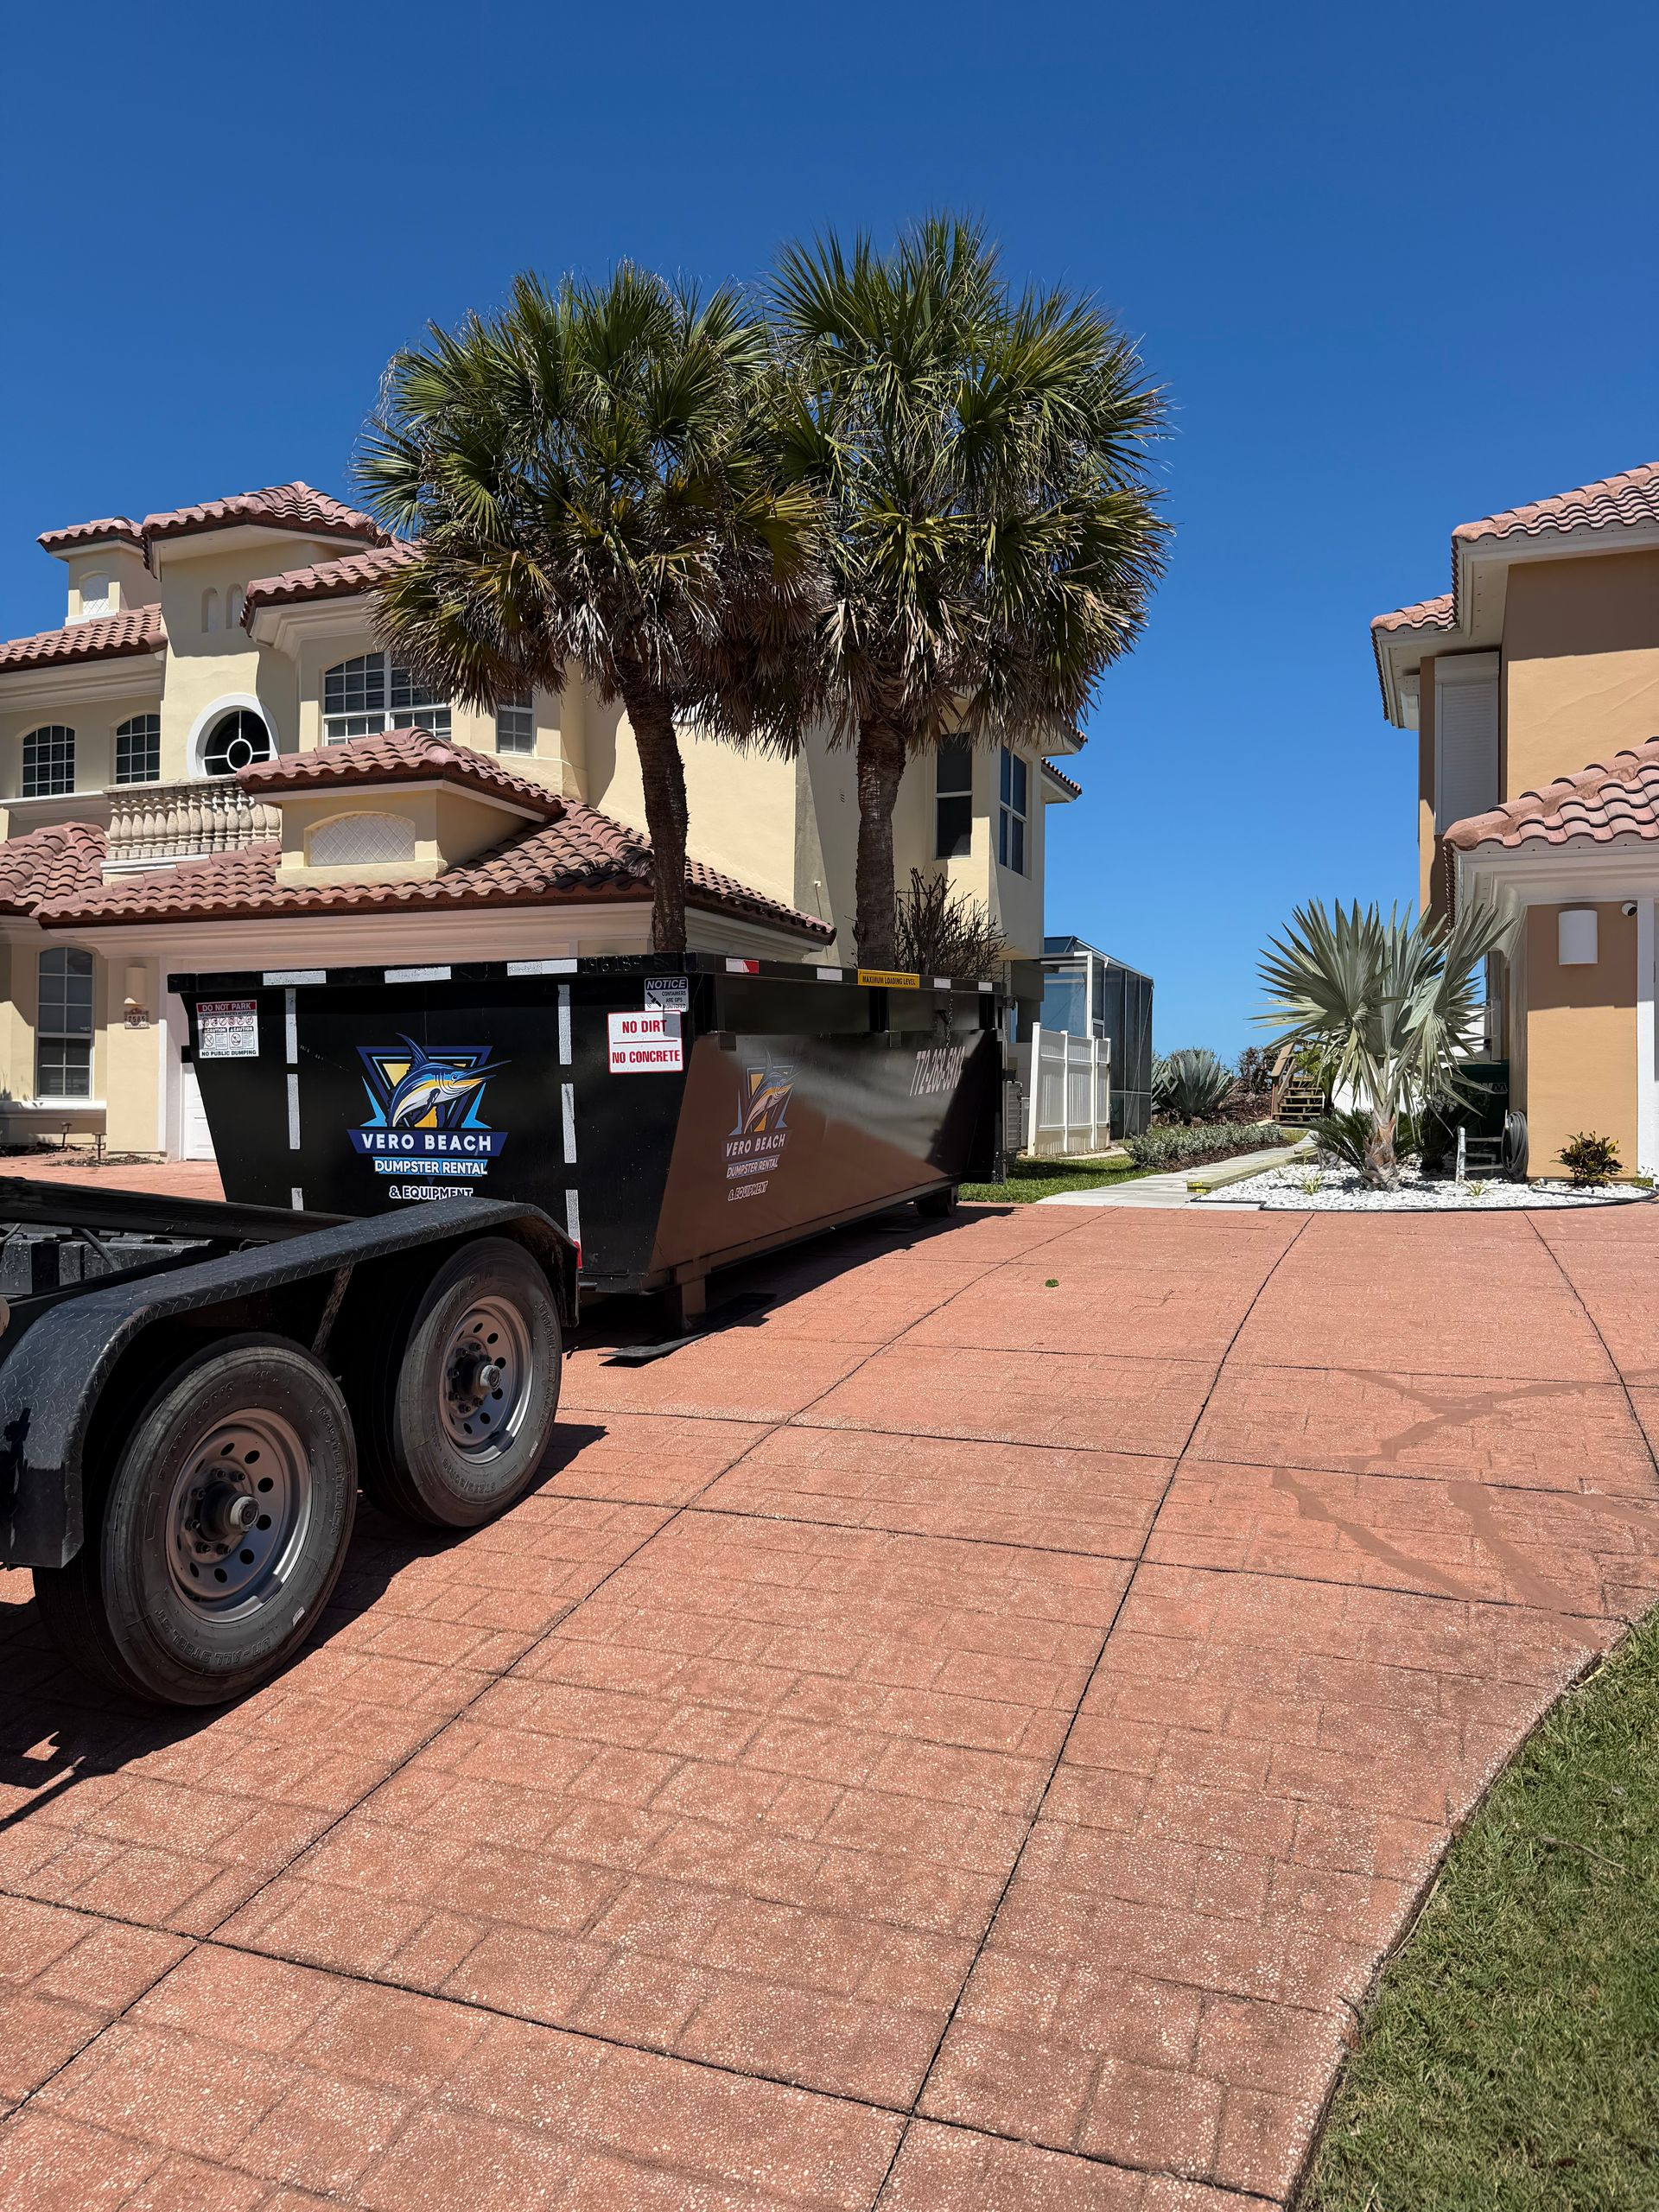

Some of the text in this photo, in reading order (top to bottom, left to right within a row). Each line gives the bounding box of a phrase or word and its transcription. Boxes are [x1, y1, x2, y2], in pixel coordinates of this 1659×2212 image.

[646, 979, 686, 989] NOTICE
[862, 976, 884, 984] MAXIMUM
[622, 1020, 667, 1033] NO DIRT
[612, 1050, 681, 1064] NO CONCRETE
[909, 1046, 965, 1096] 772-268-5913
[361, 1133, 492, 1152] VERO BEACH
[726, 1133, 786, 1157] VERO BEACH
[374, 1160, 488, 1175] DUMPSTER RENTAL
[726, 1157, 779, 1179] DUMPSTER RENTAL
[389, 1185, 474, 1200] & EQUIPMENT
[728, 1180, 769, 1202] & EQUIPMENT
[173, 1628, 213, 1665] STEEL
